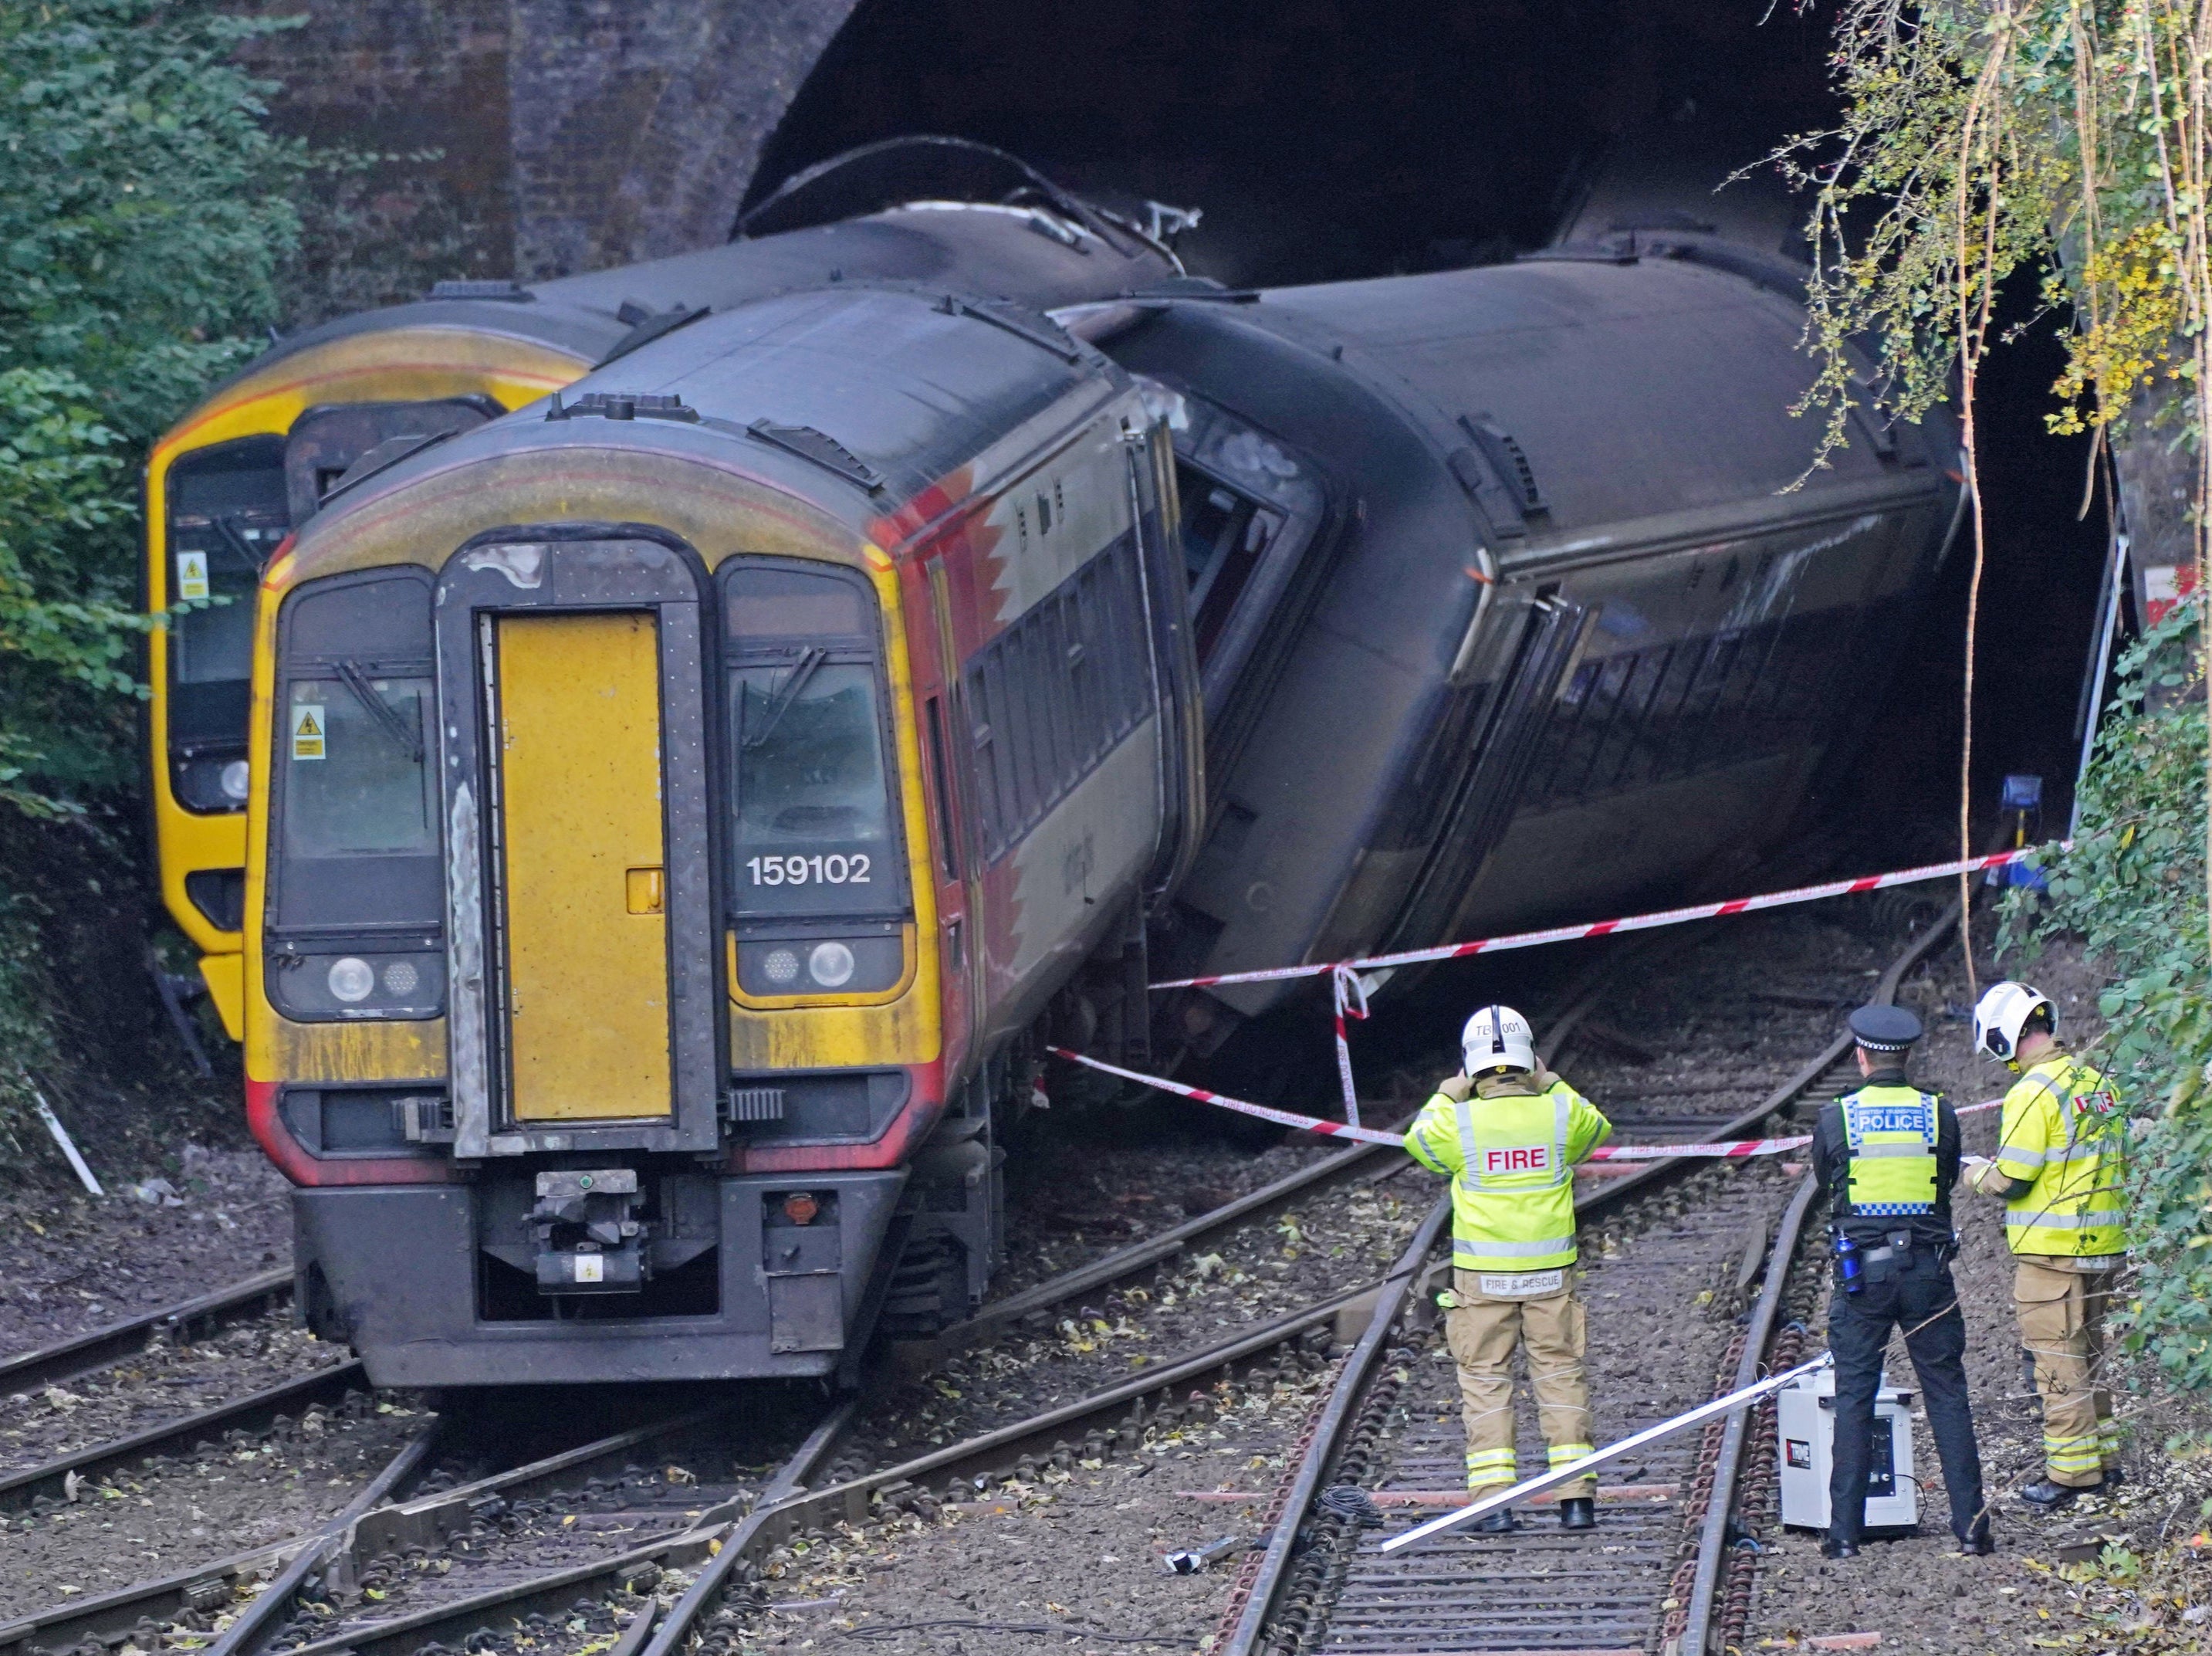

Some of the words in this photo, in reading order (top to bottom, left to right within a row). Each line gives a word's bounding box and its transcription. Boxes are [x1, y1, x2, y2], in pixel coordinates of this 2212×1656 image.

[746, 854, 871, 886] 159102
[1952, 858, 1981, 870] CRSS
[1476, 1024, 1492, 1036] TB
[1502, 1022, 1521, 1035] 001
[1222, 1098, 1241, 1110] FIRE
[1243, 1102, 1257, 1114] DO
[1259, 1105, 1277, 1119] NOT
[1279, 1110, 1310, 1126] CROSS
[1859, 1114, 1925, 1131] POLICE
[1632, 1145, 1652, 1154] FIRE
[1654, 1144, 1669, 1154] DO
[1671, 1144, 1690, 1153] NOT
[1693, 1143, 1724, 1153] CROSS
[1487, 1148, 1546, 1171] FIRE
[1486, 1279, 1507, 1290] FIRE
[1510, 1279, 1518, 1290] &
[1522, 1275, 1559, 1289] RESCUE
